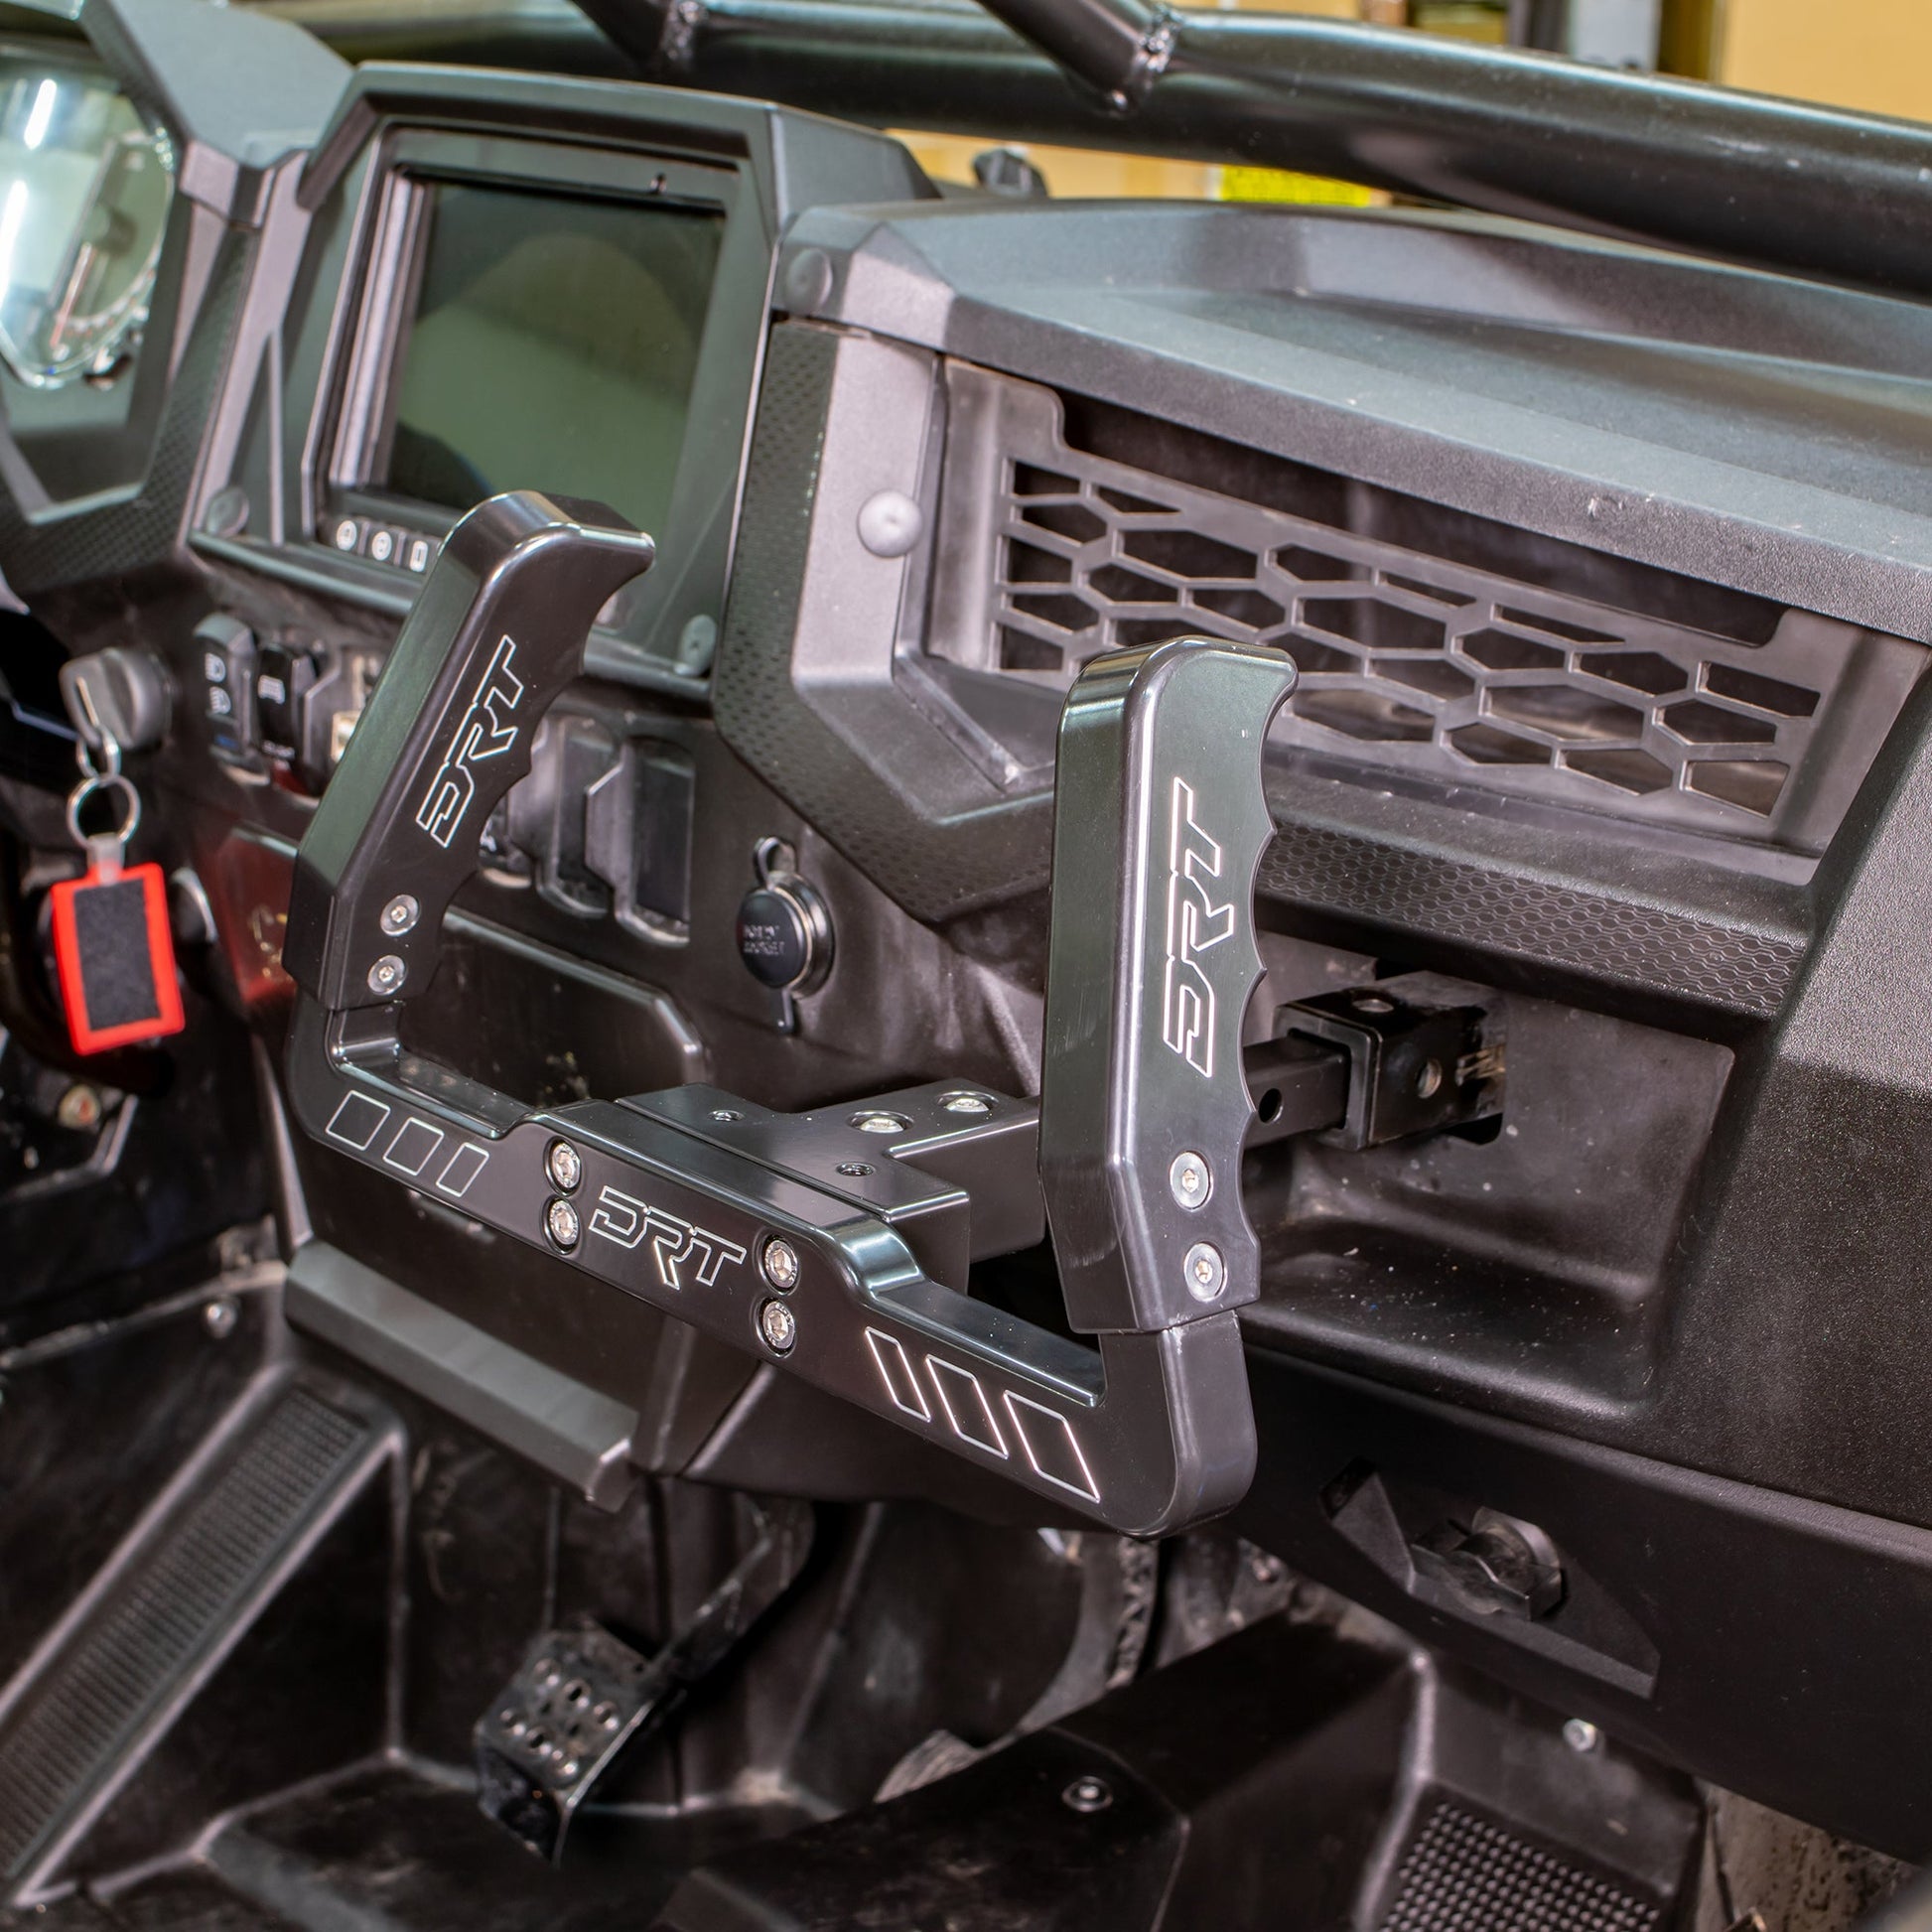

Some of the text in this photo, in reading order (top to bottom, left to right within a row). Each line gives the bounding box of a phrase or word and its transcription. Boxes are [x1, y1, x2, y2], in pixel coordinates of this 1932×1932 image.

[416, 634, 524, 848] DRT
[1163, 776, 1234, 1078] DRT
[589, 1185, 747, 1291] DRT
